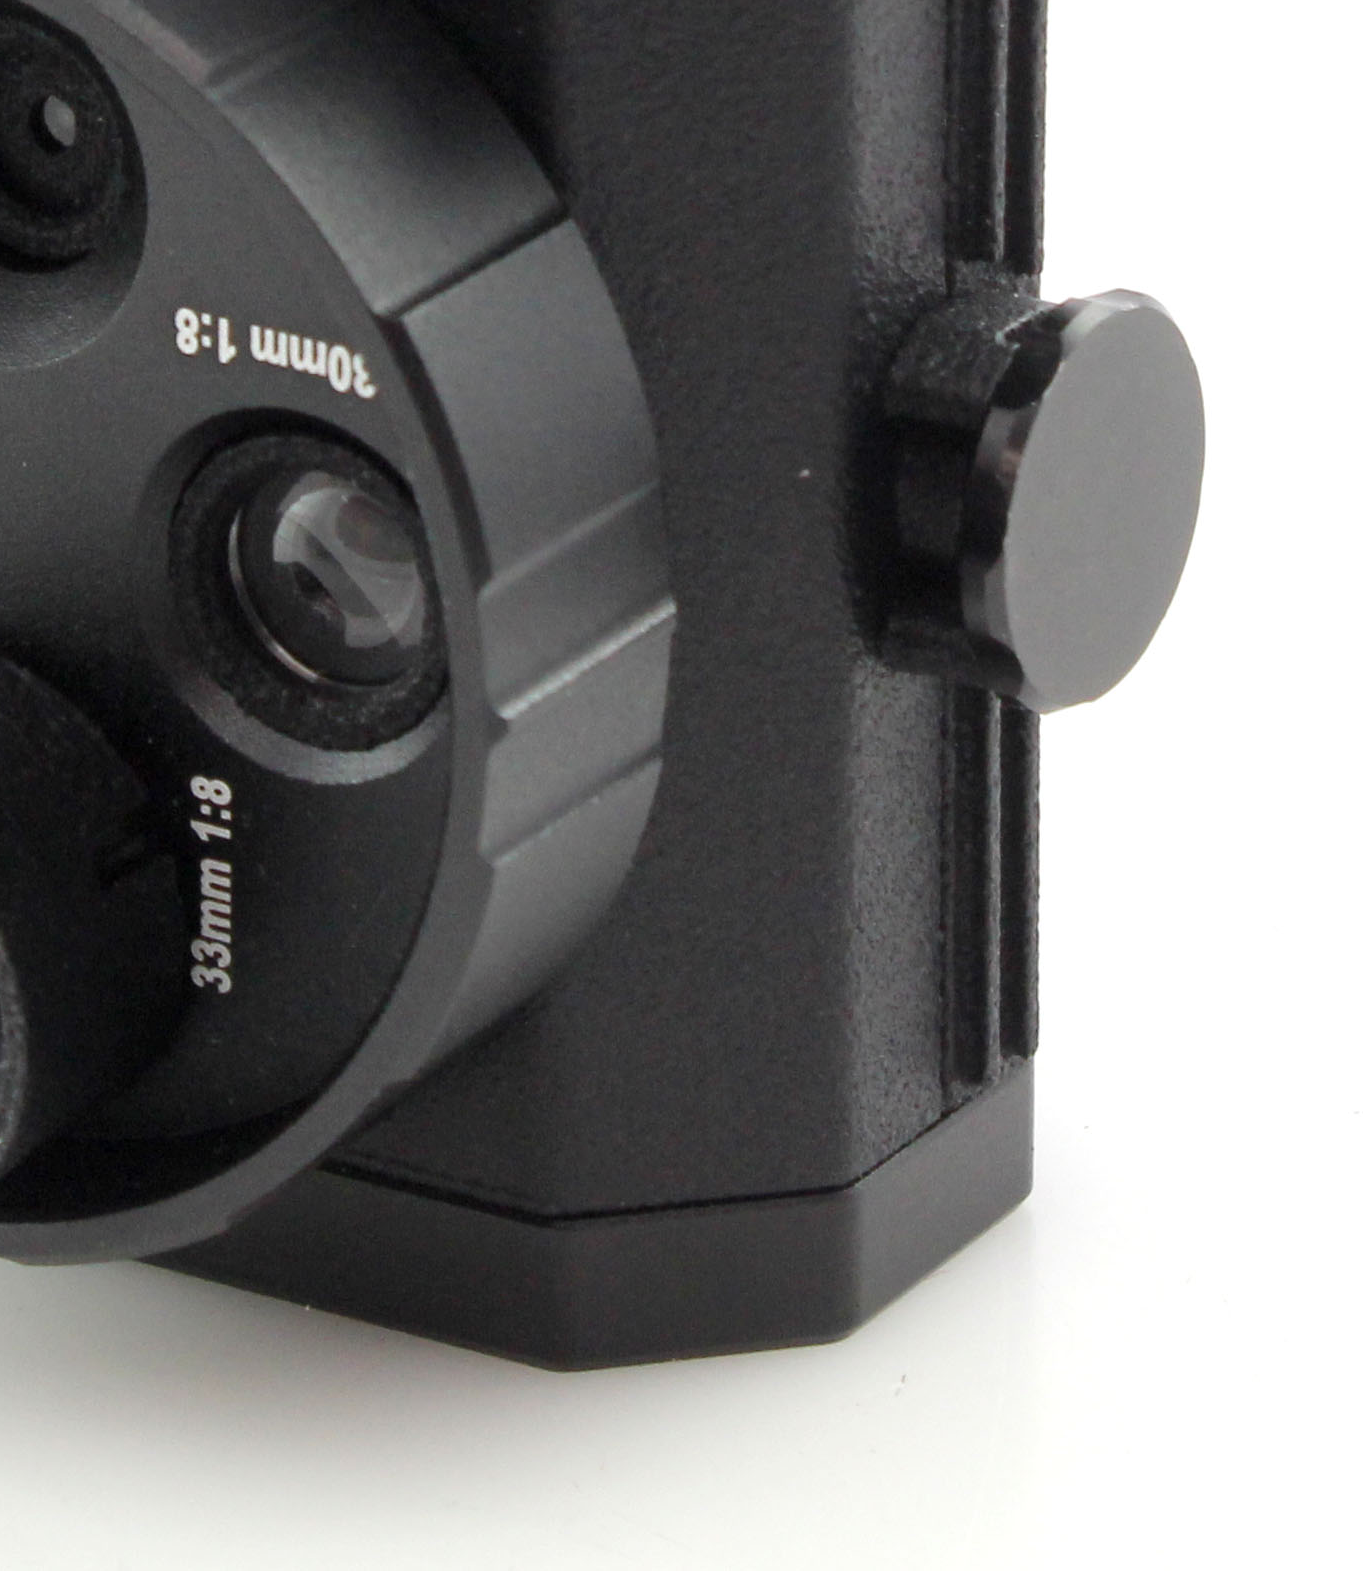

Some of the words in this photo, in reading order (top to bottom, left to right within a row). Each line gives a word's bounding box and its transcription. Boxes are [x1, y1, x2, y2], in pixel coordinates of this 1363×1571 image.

[174, 307, 237, 364] 1:8
[250, 324, 378, 399] 30mm
[189, 775, 232, 842] 1:8
[190, 858, 232, 994] 33mm
